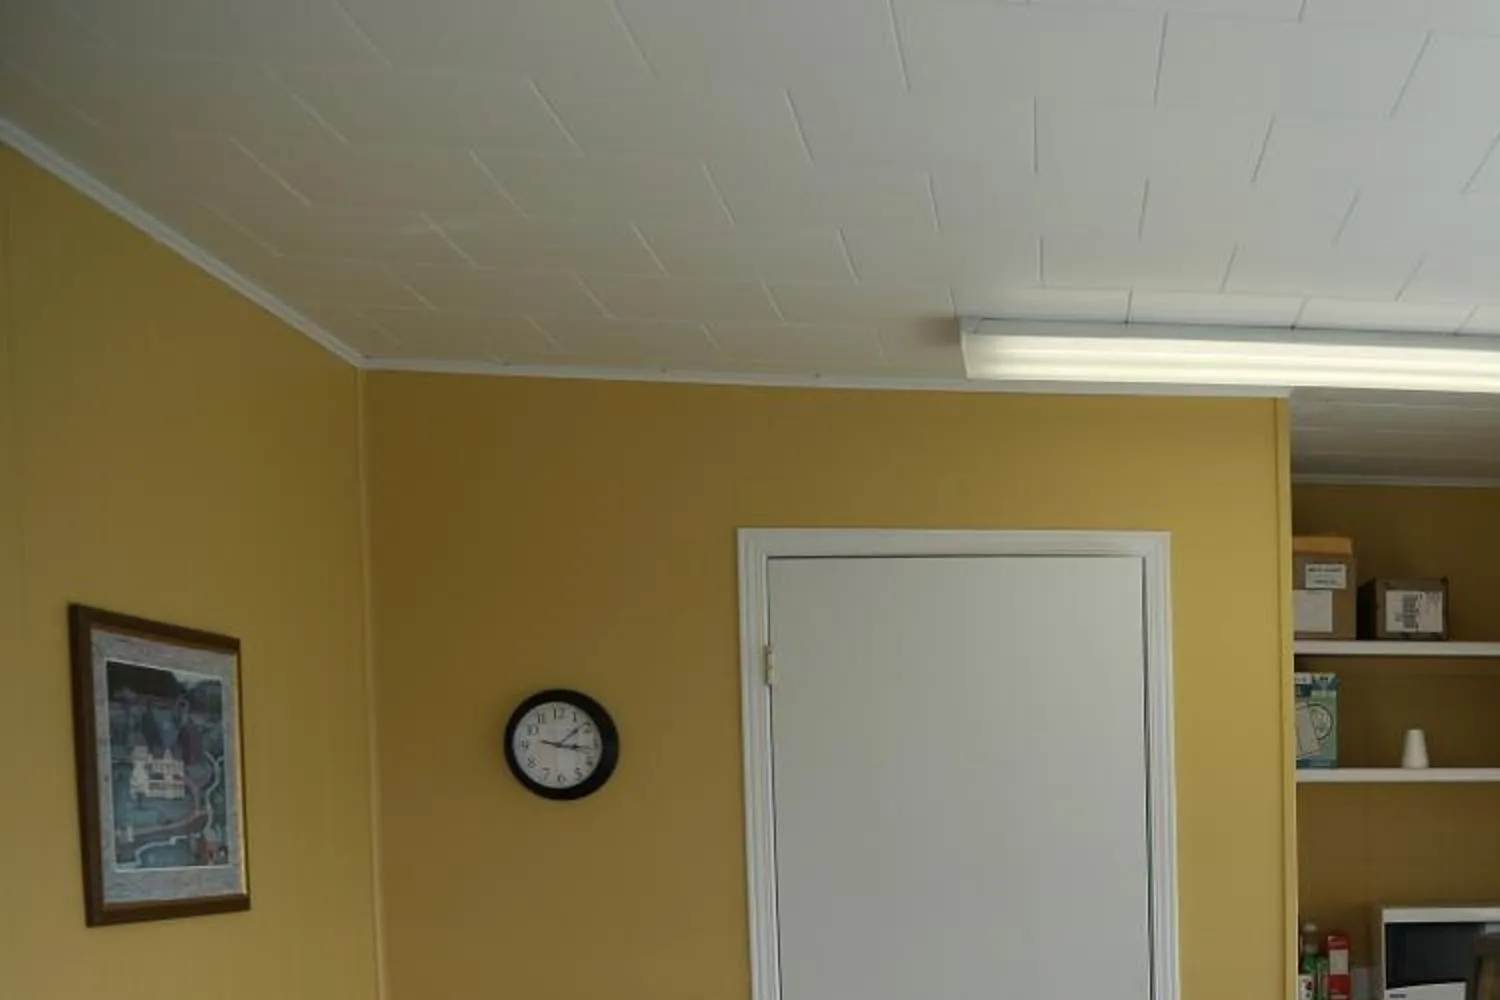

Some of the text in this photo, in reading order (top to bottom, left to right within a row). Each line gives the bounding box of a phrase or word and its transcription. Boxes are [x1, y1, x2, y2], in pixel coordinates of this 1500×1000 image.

[537, 713, 545, 724] 11
[552, 707, 565, 720] 12
[527, 724, 538, 735] 10
